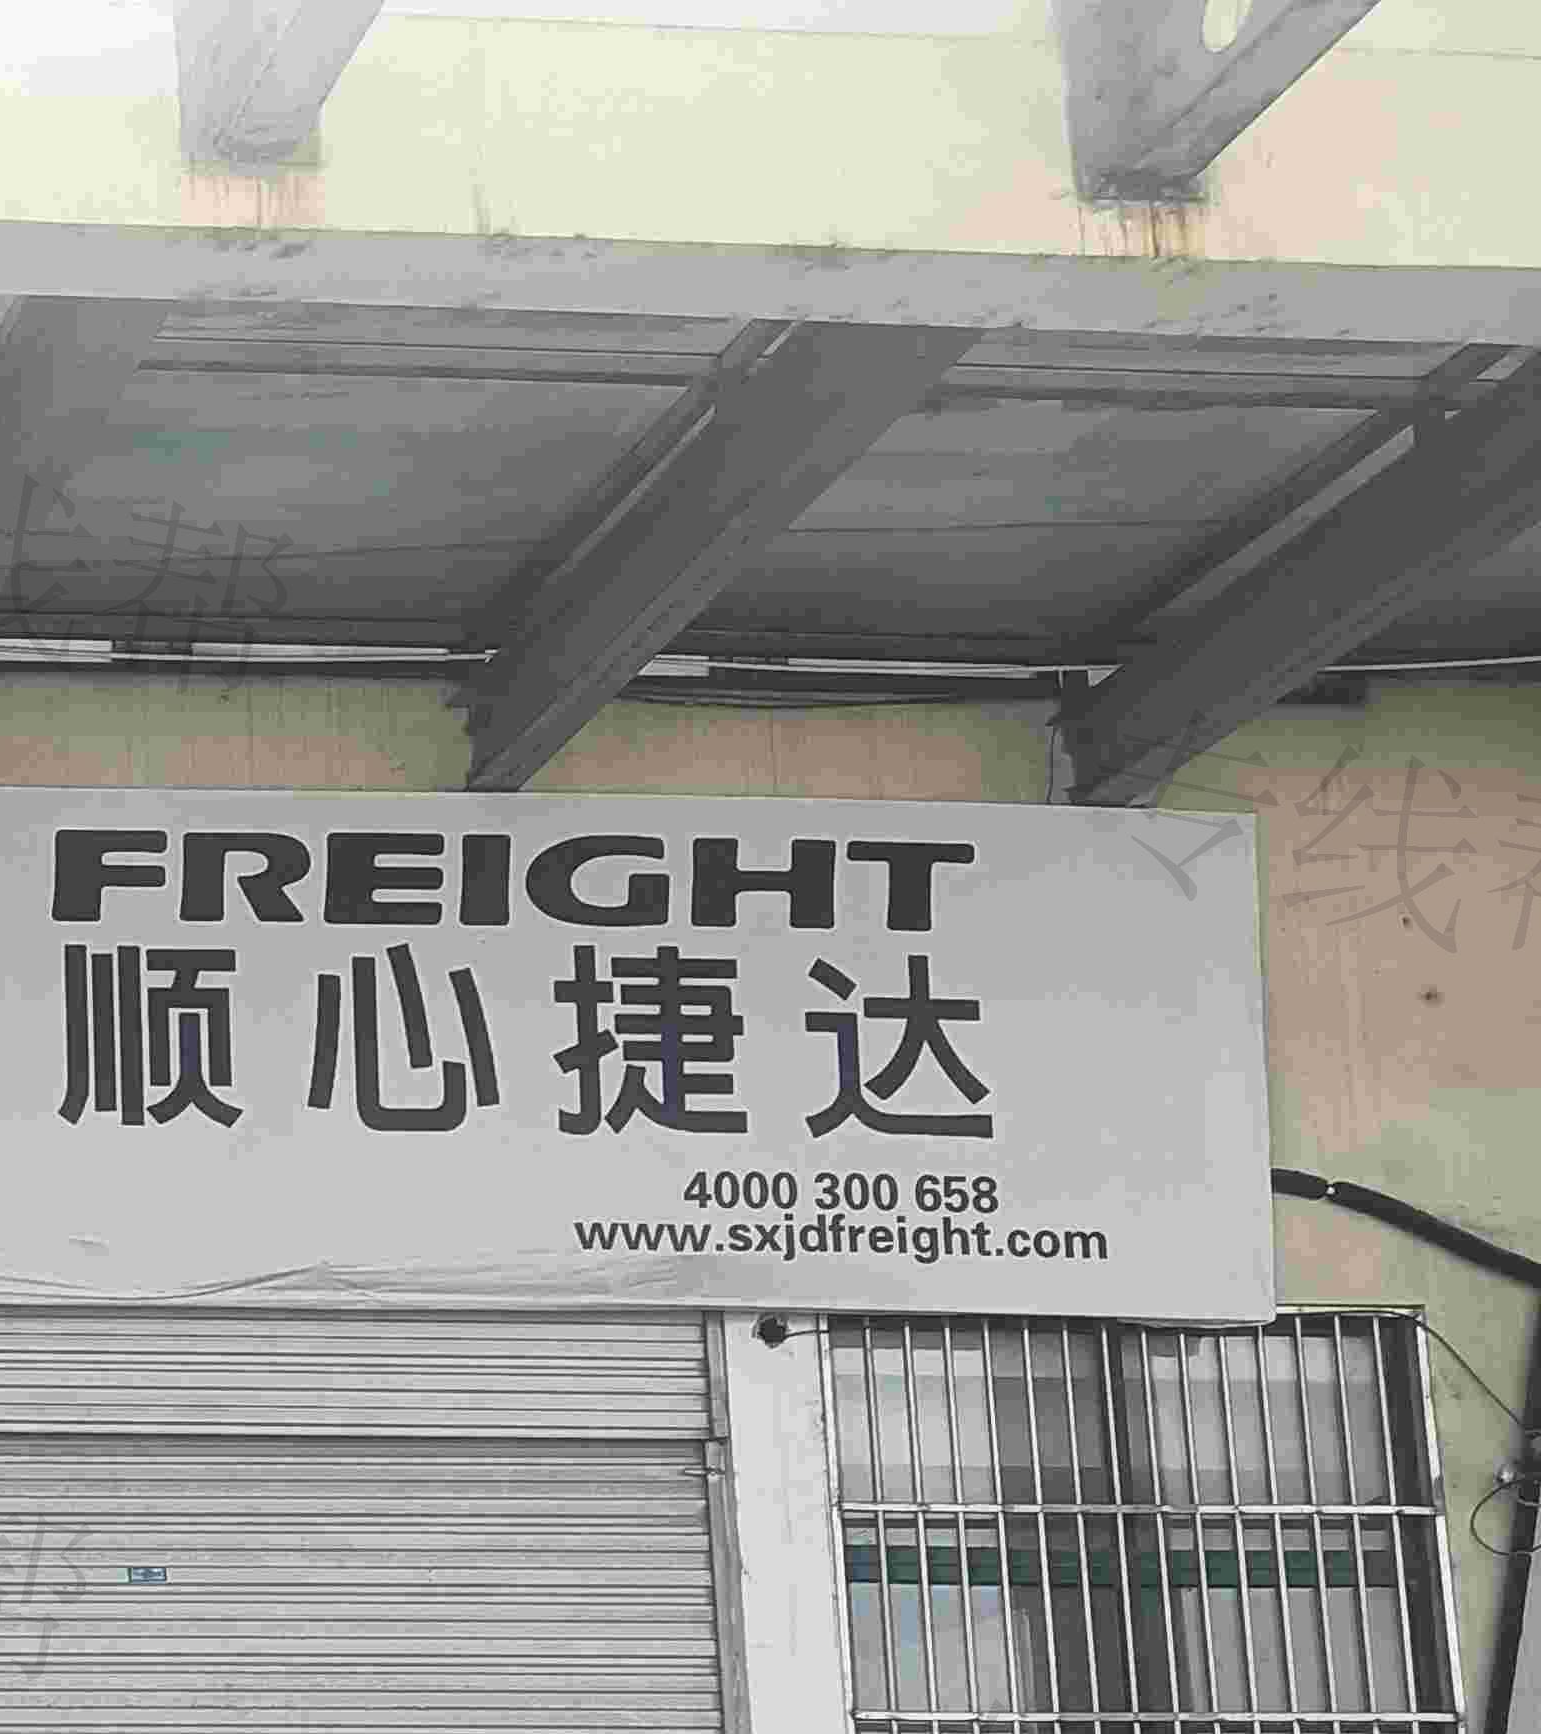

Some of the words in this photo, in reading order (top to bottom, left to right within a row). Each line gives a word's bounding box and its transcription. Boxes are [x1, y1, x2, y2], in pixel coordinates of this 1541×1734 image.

[51, 829, 976, 932] FREIGHT
[58, 943, 994, 1139] 顺心捷达
[684, 1171, 798, 1210] 4000
[814, 1172, 899, 1212] 300
[915, 1174, 999, 1214] 658
[575, 1216, 1108, 1264] www.sxjdfreight.com
